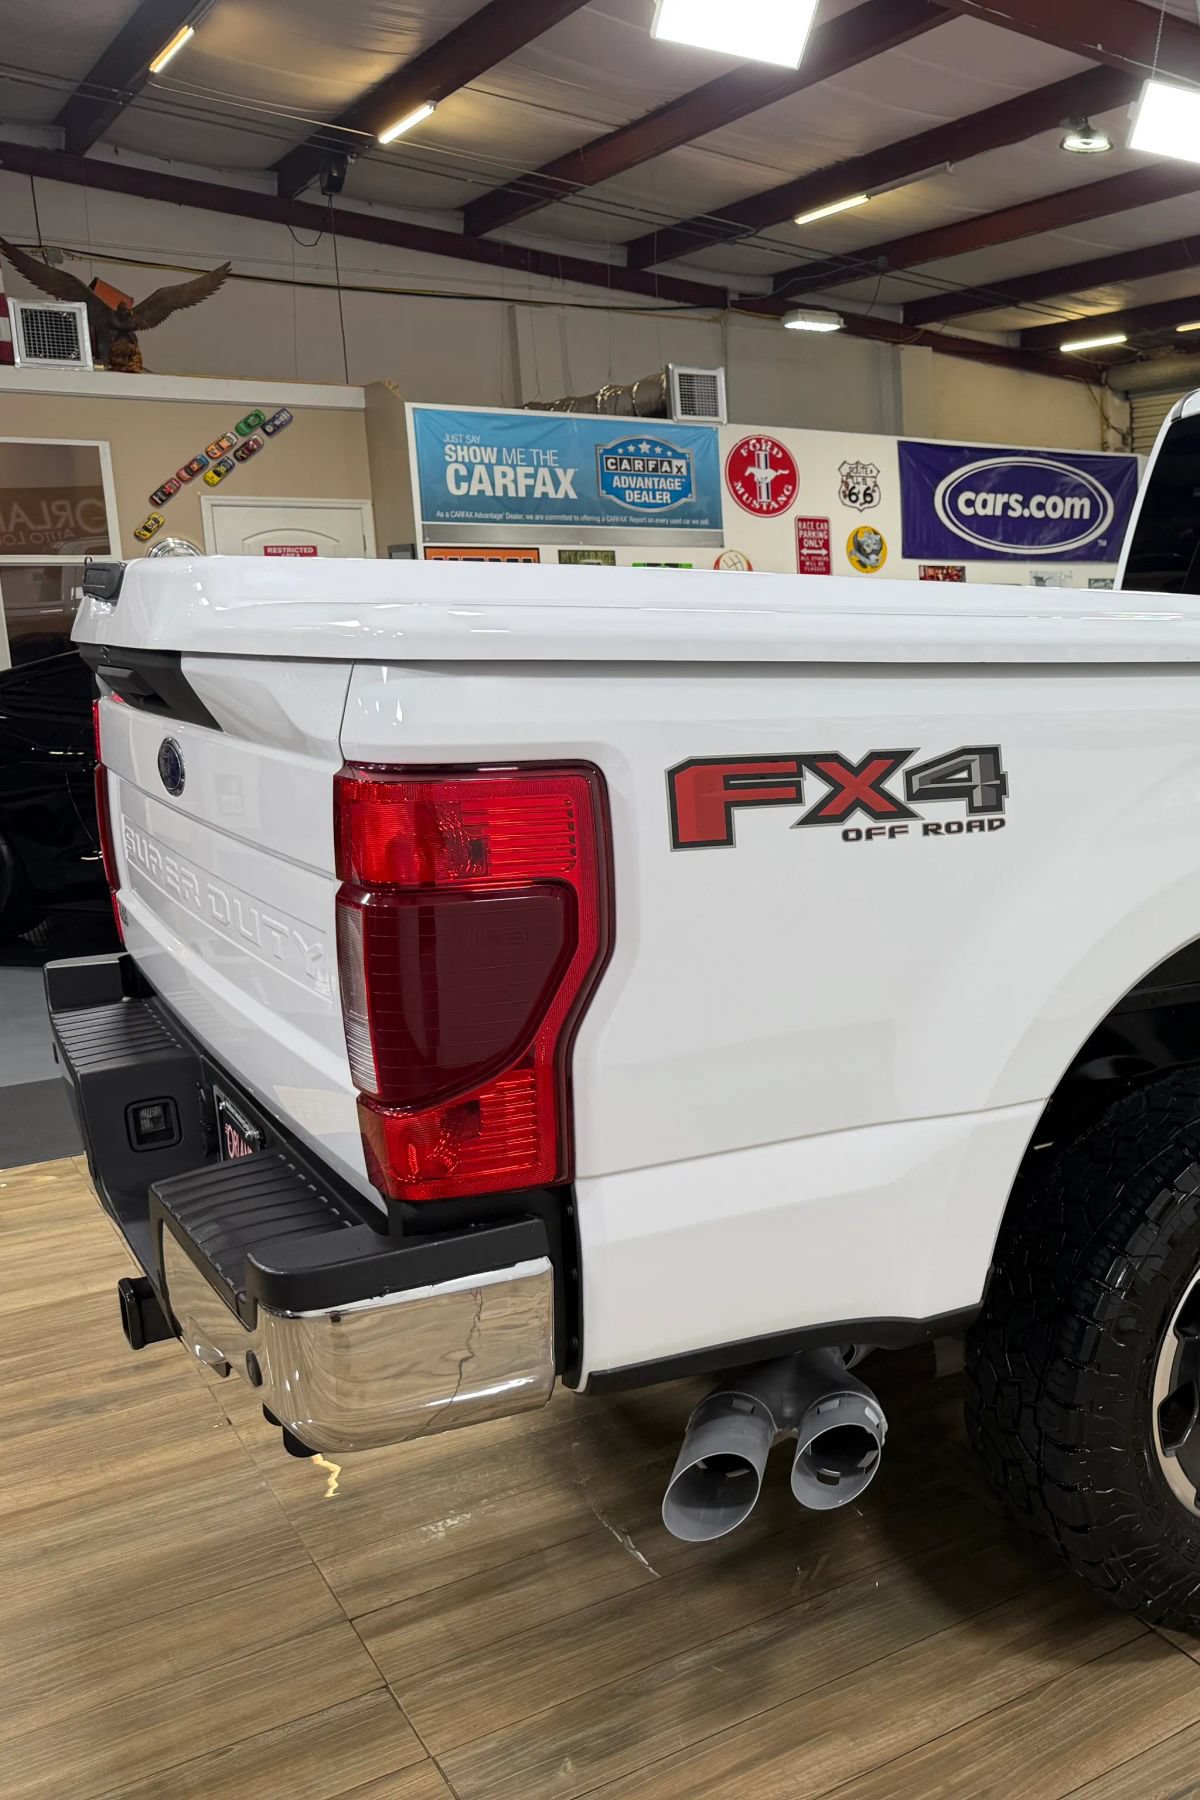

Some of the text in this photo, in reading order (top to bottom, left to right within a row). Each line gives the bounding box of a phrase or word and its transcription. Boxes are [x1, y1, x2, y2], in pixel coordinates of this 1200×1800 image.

[443, 434, 481, 444] JUST SAY
[740, 439, 783, 458] FORD
[444, 444, 559, 467] SHOW ME THE
[606, 457, 684, 475] CARFAX
[446, 462, 578, 499] CARFAX
[612, 476, 682, 491] ADVANTAGE
[625, 490, 671, 504] DEALER
[734, 481, 793, 511] MUSTANG
[848, 485, 874, 504] 66
[957, 490, 1091, 520] cars.com
[799, 530, 829, 539] PARKING
[803, 539, 824, 548] ONLY
[266, 546, 314, 554] RESTRICTED
[664, 744, 1009, 852] FX4
[841, 817, 1007, 843] OFF ROAD
[124, 825, 324, 981] SUPER DUTY
